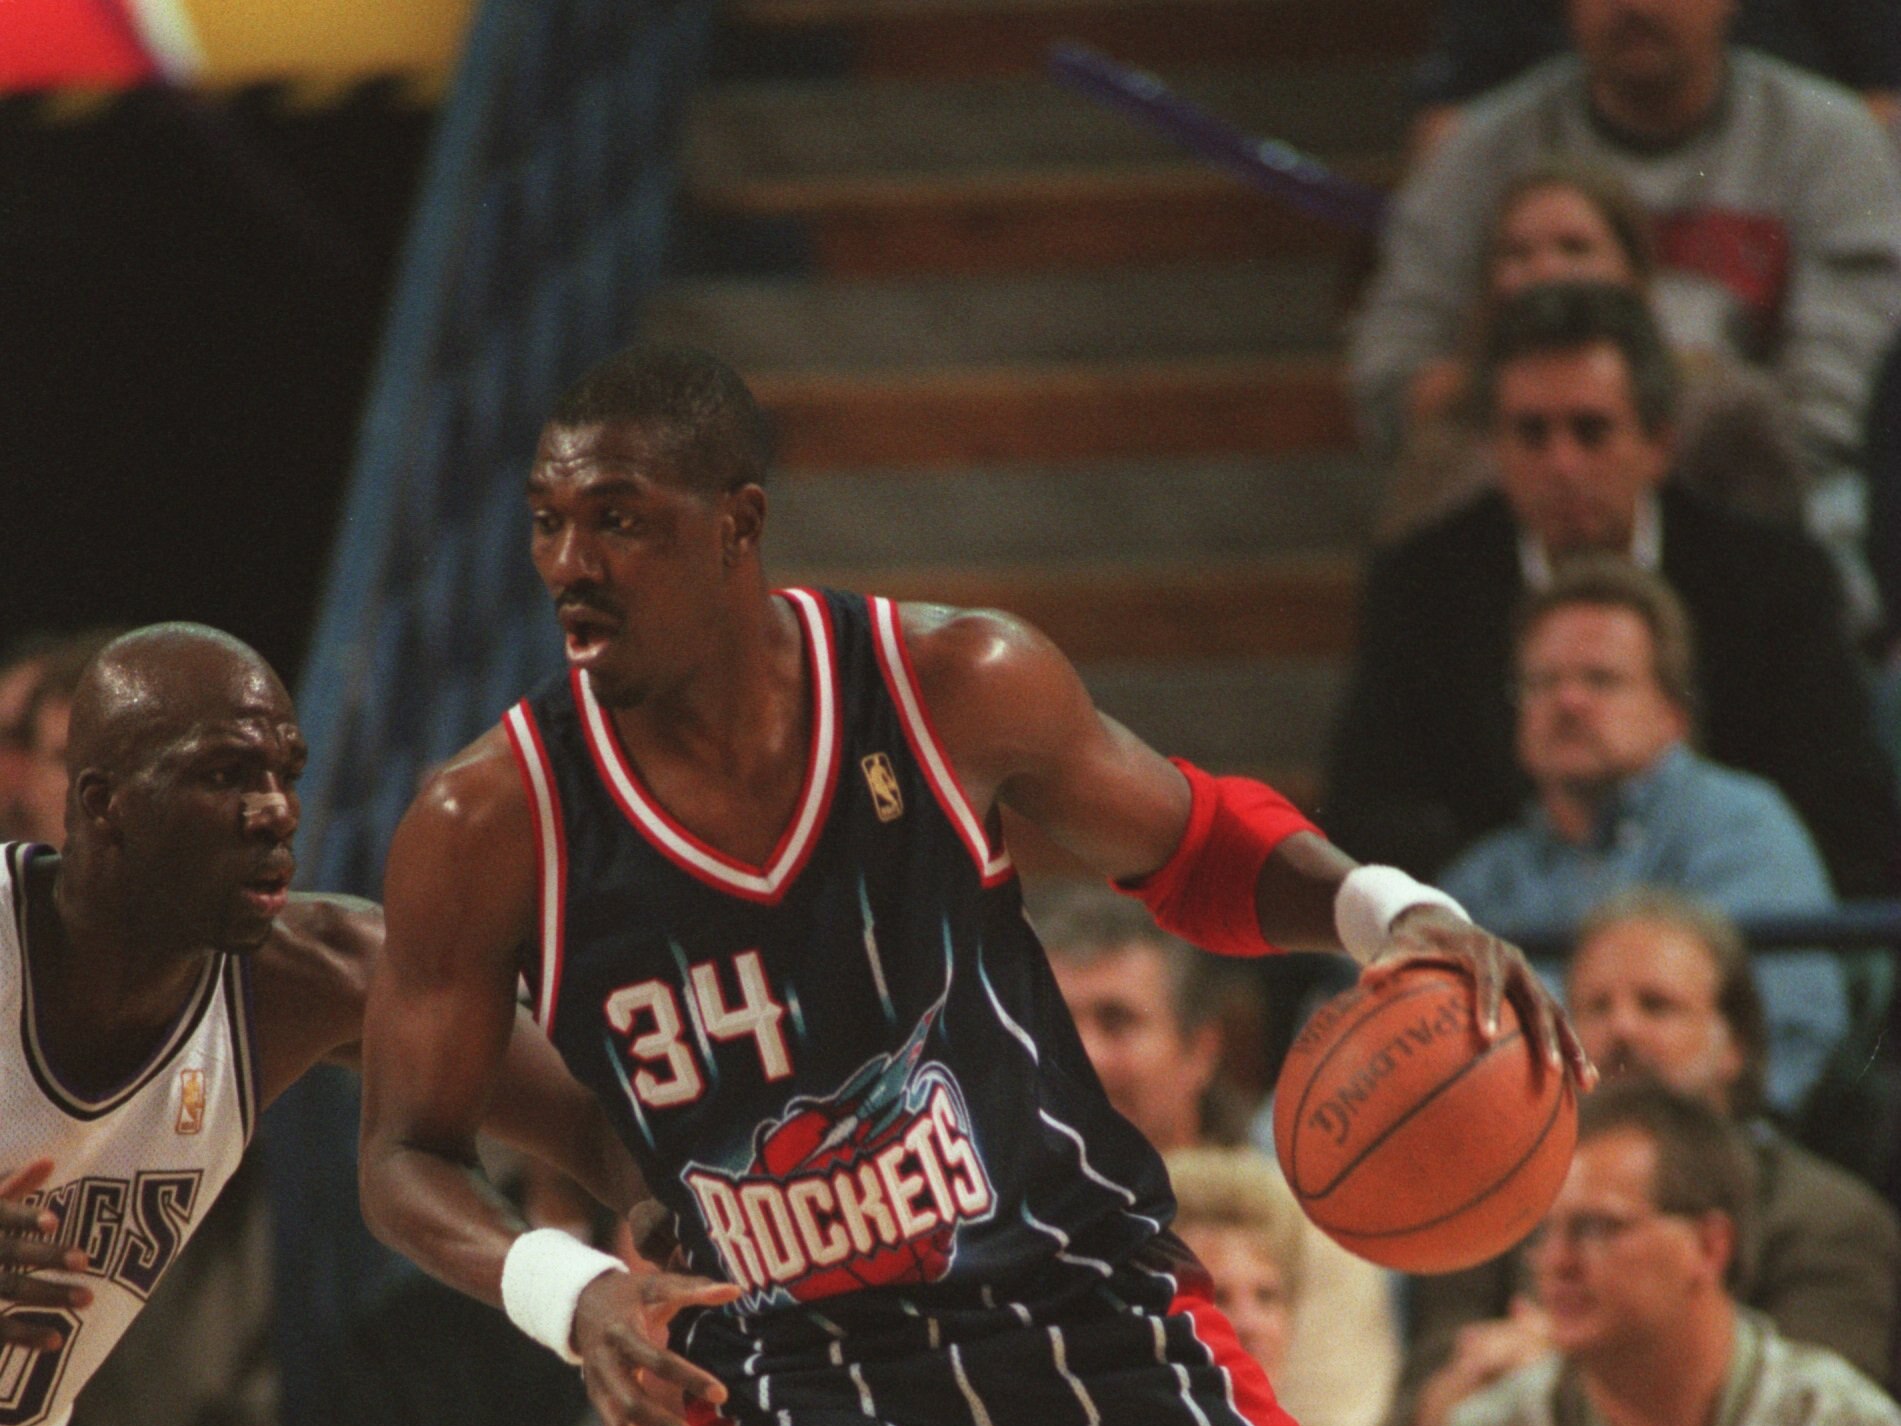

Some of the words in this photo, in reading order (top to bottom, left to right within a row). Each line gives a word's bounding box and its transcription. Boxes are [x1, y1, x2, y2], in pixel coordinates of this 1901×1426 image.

[604, 948, 794, 1109] 34
[10, 1169, 204, 1303] NGS
[688, 1084, 992, 1292] ROCKETS
